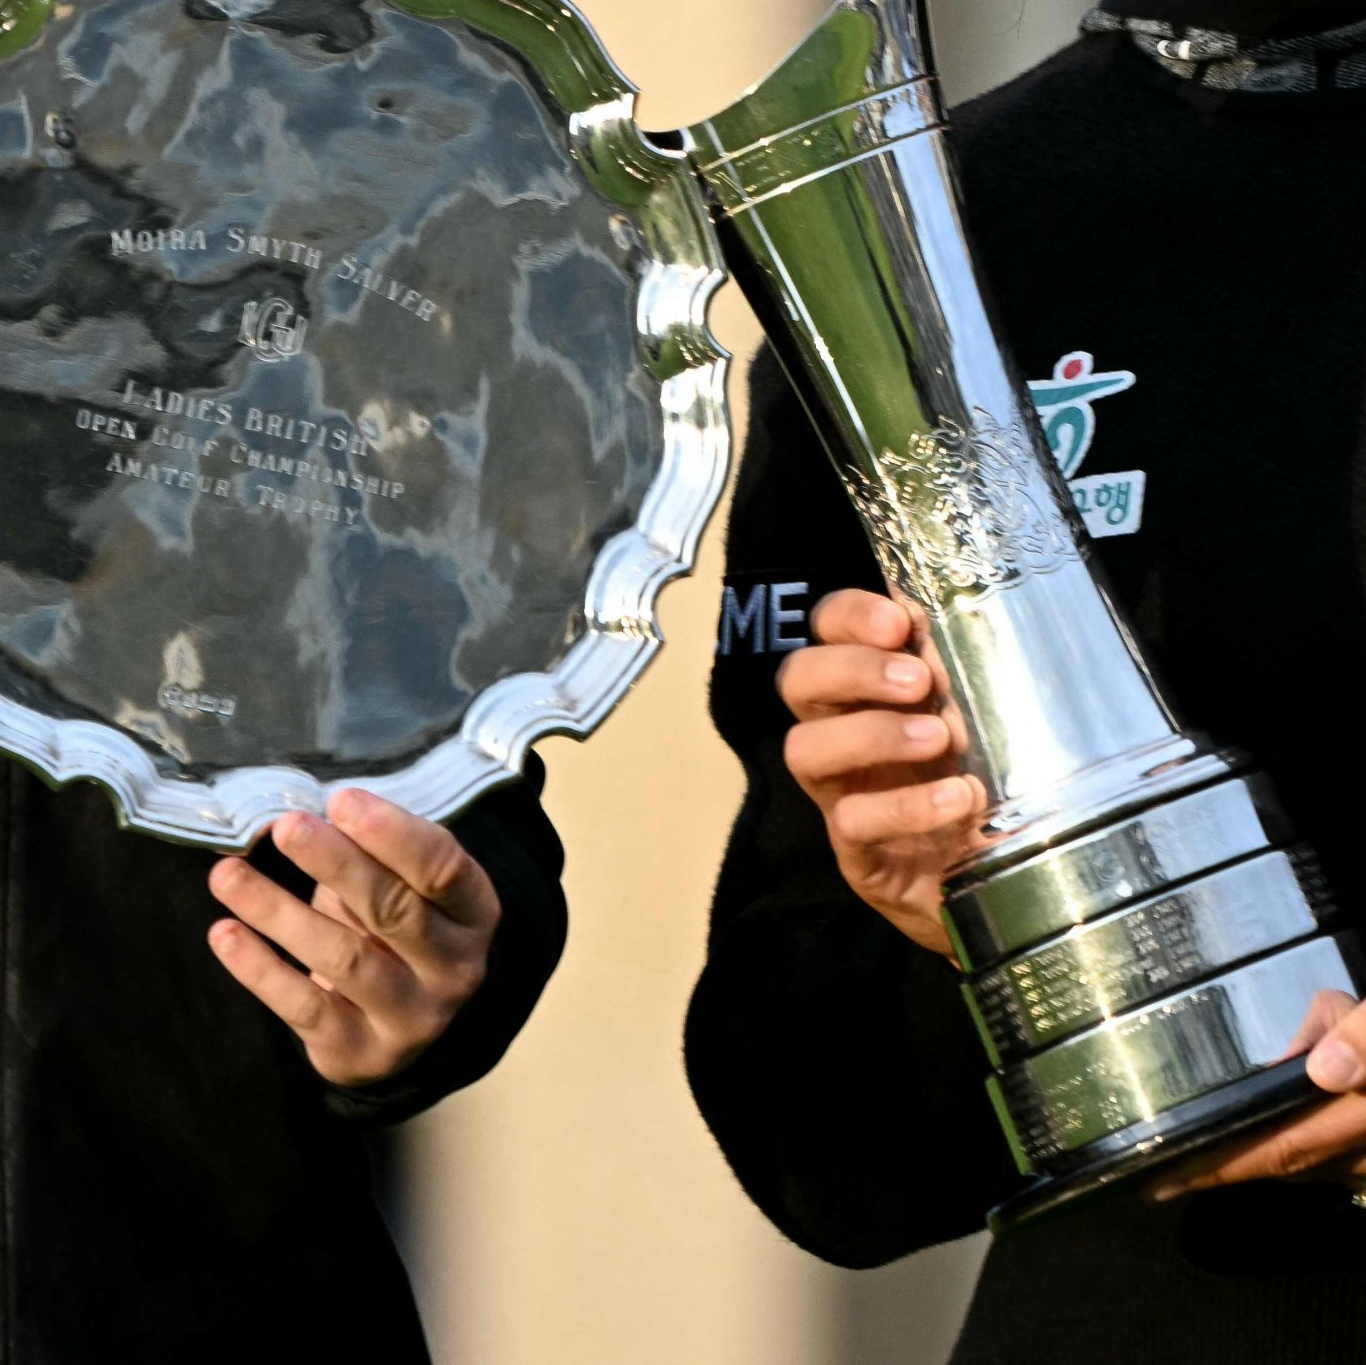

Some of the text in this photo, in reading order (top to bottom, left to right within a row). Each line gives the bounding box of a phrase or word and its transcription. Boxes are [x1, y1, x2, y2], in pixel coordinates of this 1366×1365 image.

[110, 228, 208, 257] MOIRA
[227, 228, 323, 270] SMYTH
[75, 409, 137, 440] OPEN
[230, 443, 405, 499] CHAMPIONSHIP
[122, 379, 368, 457] LADIES BRITISH
[106, 452, 361, 525] AMATEUR TROPHY
[716, 581, 810, 656] ME
